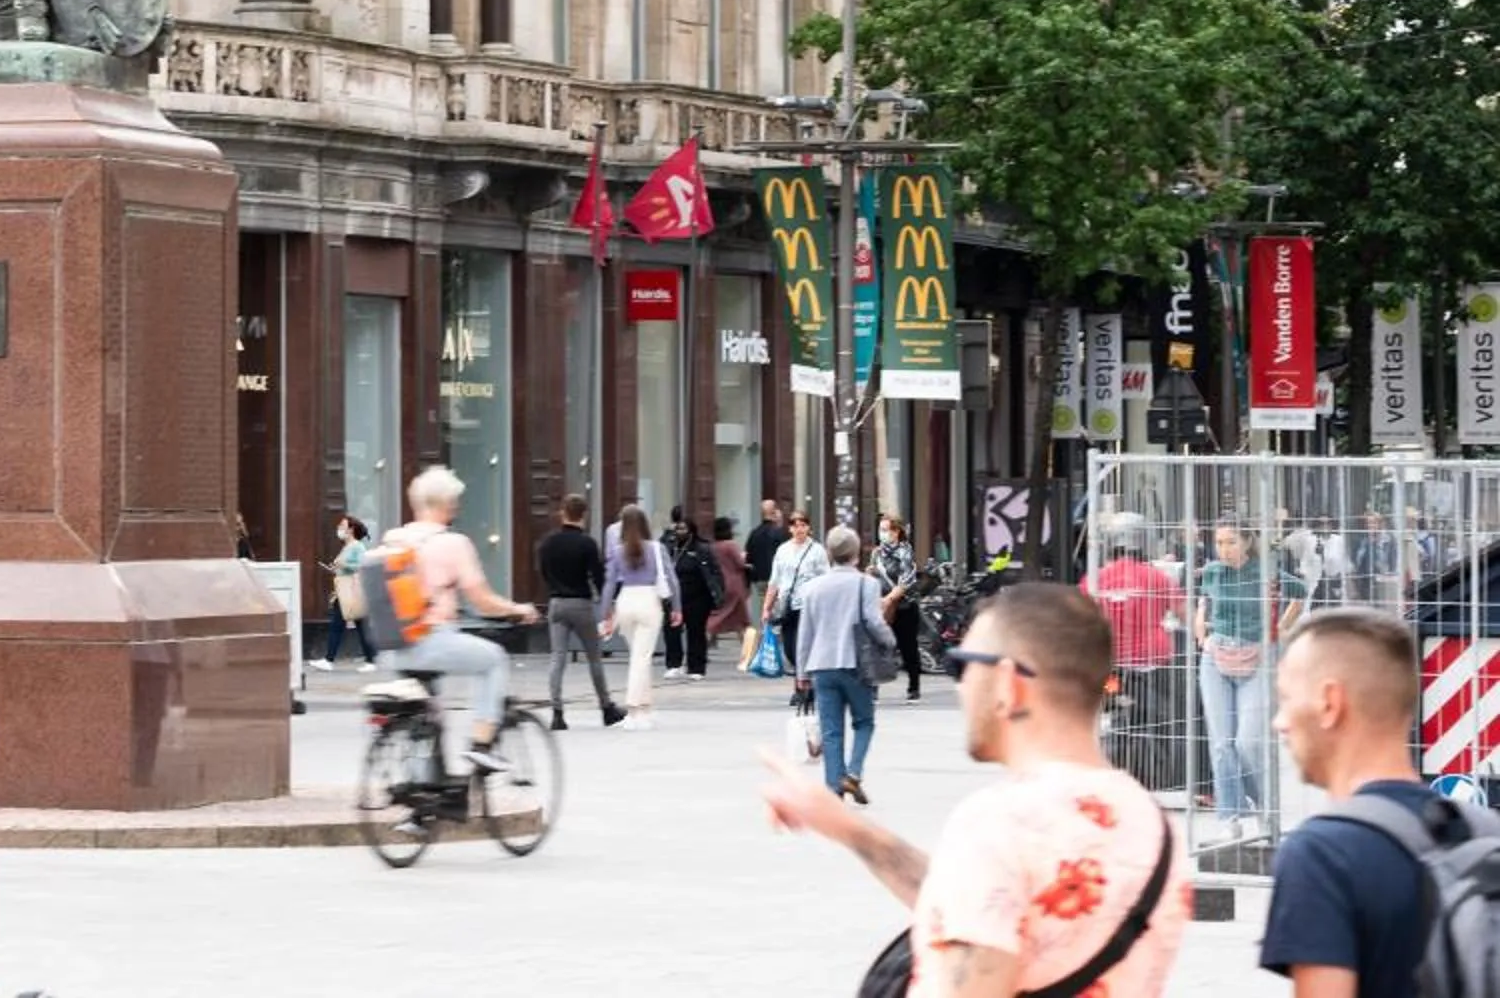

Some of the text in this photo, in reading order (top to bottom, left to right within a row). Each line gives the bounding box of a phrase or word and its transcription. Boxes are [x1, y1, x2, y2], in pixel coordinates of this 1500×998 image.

[1273, 244, 1293, 363] Vanden Borre
[1096, 320, 1117, 401] veritas
[1381, 332, 1405, 423] veritas
[1470, 332, 1494, 423] veritas
